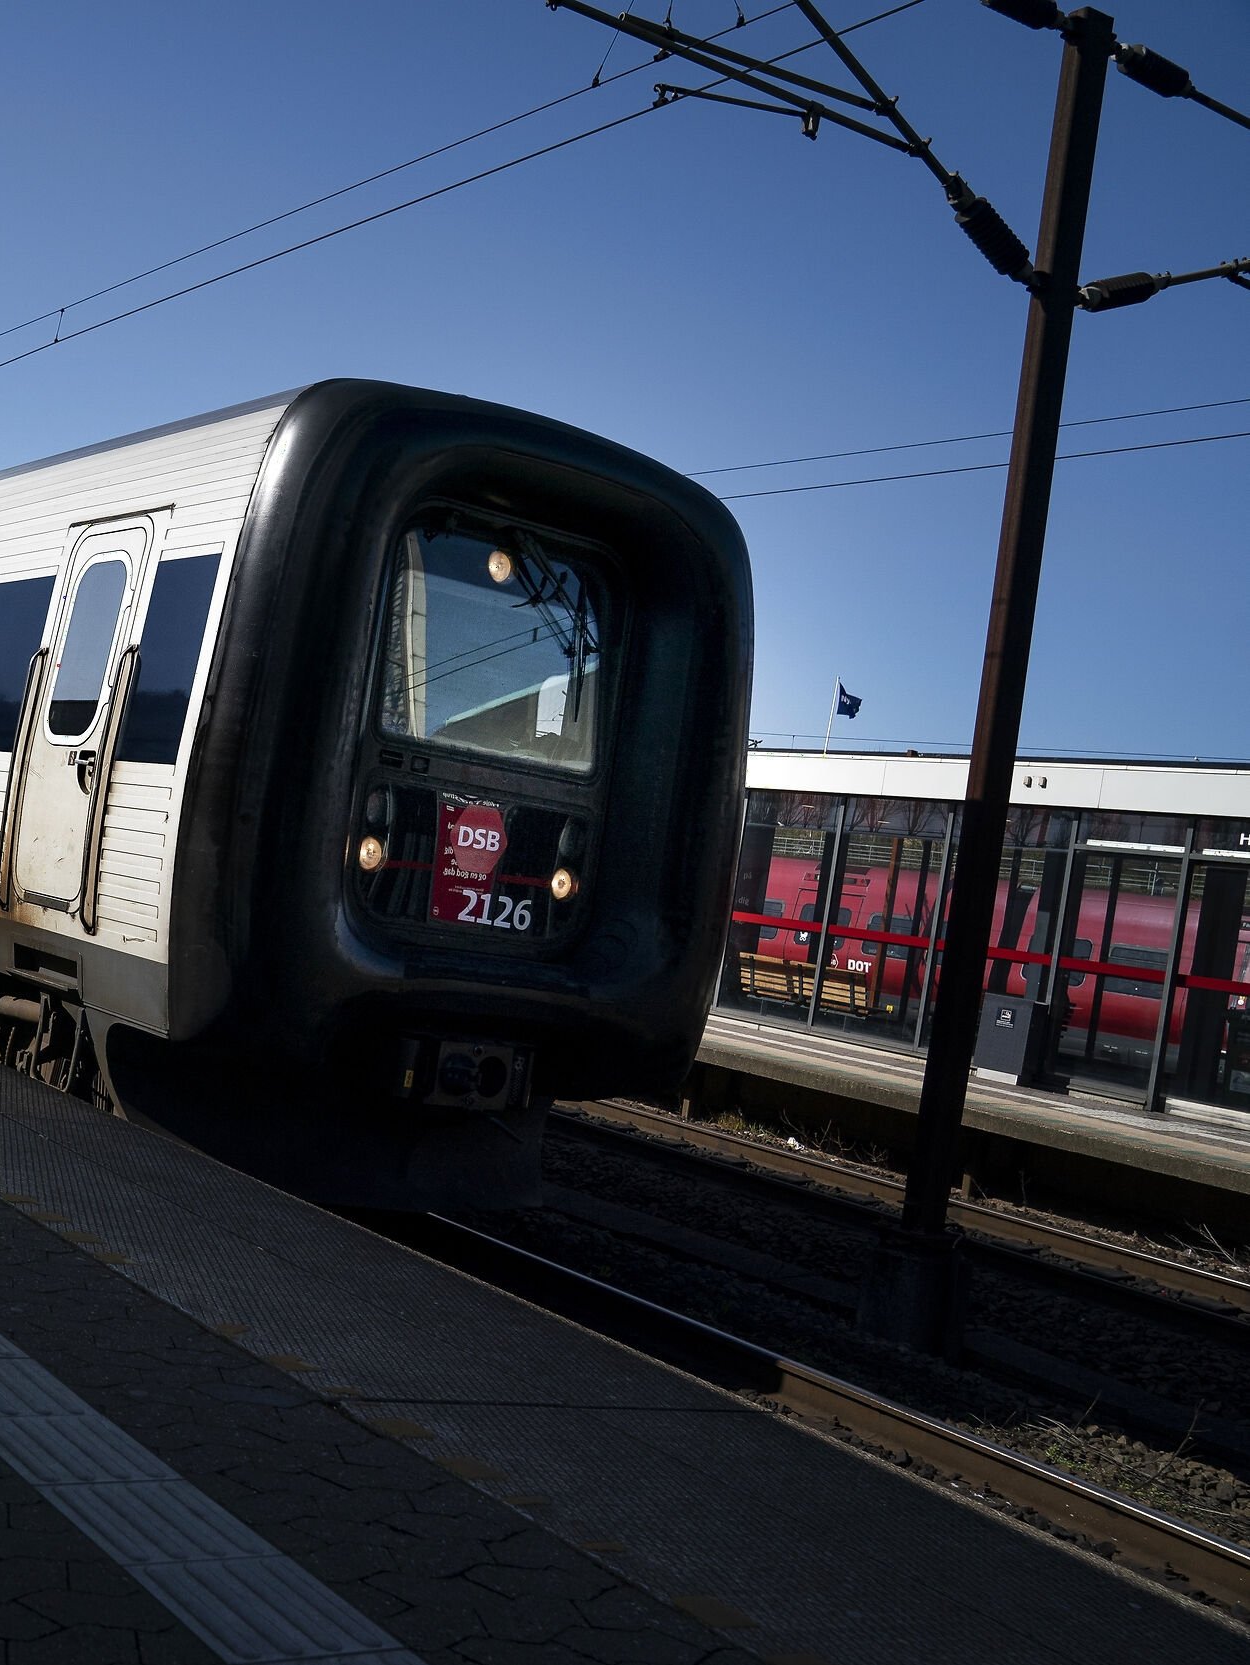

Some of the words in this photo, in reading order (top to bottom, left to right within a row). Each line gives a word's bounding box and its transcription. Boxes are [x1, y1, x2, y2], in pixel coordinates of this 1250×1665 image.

[457, 826, 500, 851] DSB
[457, 889, 532, 931] 2126
[847, 958, 872, 974] DOT
